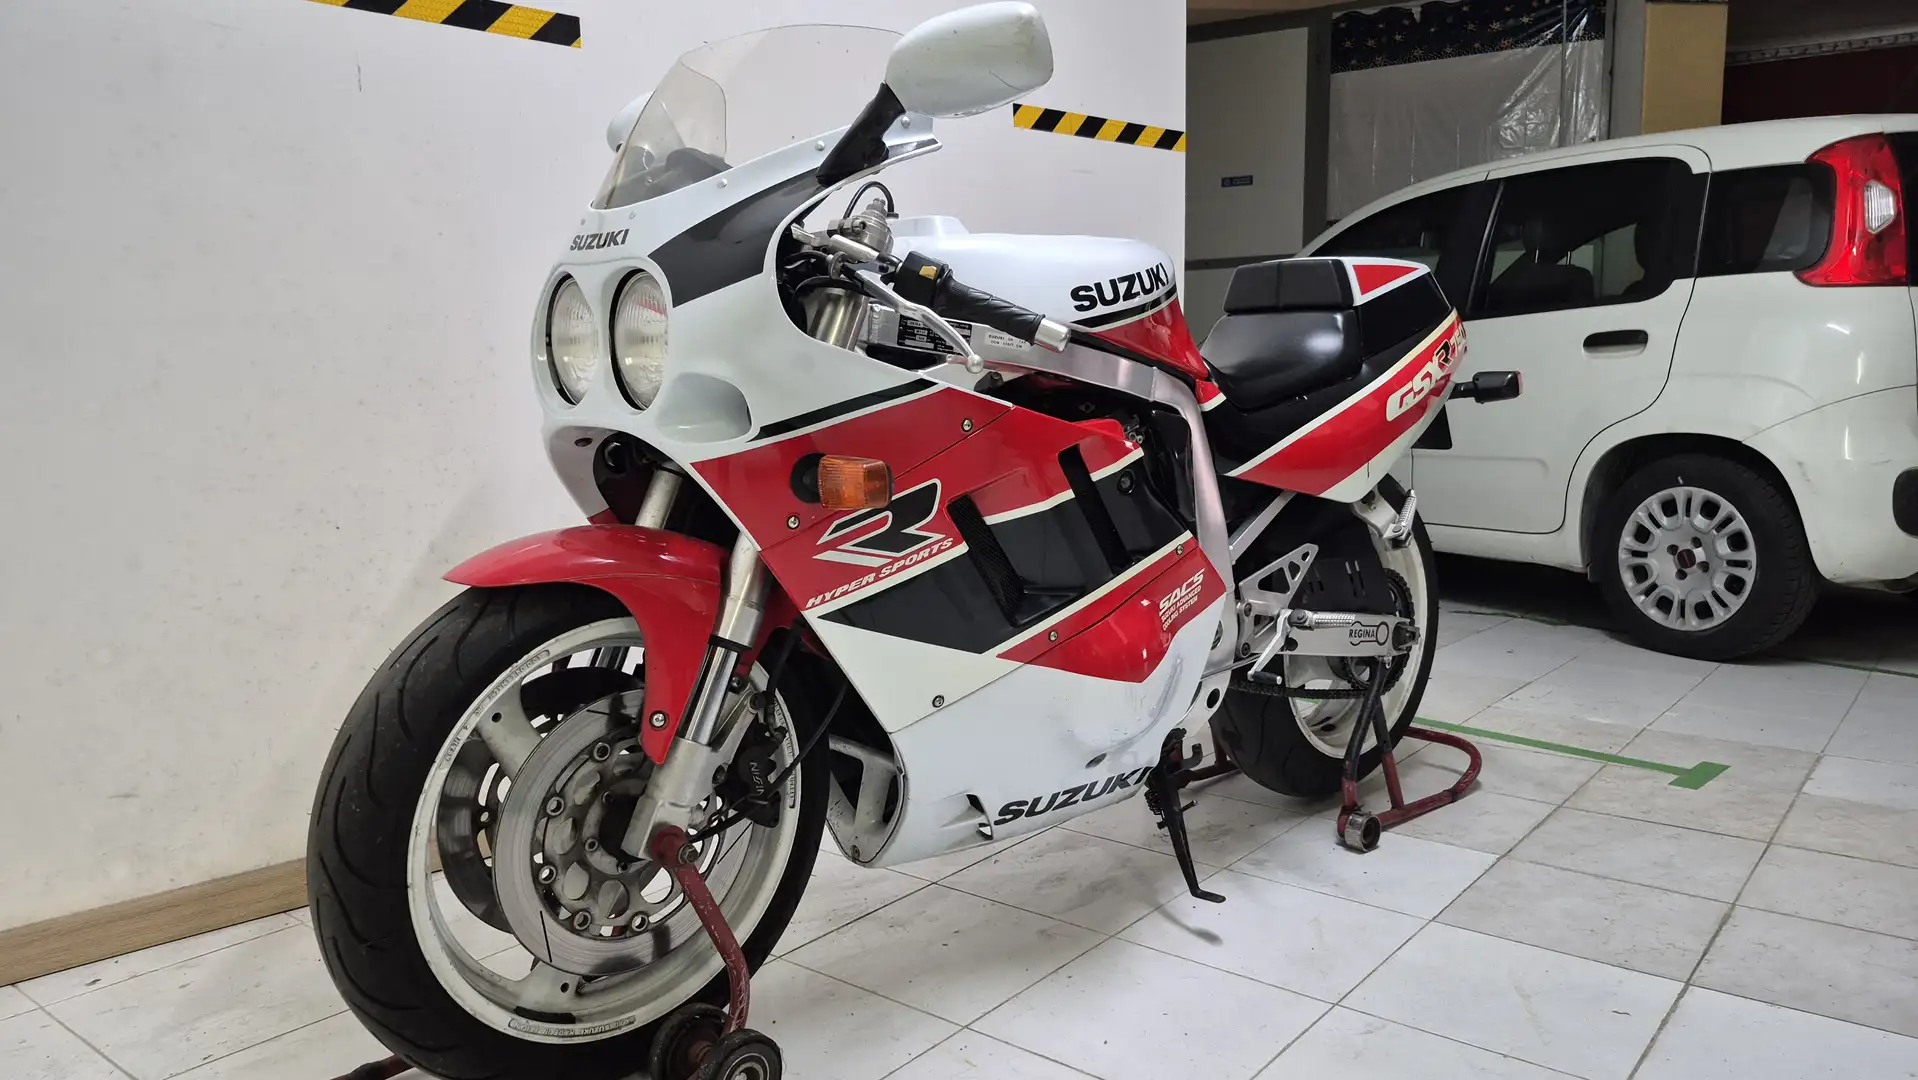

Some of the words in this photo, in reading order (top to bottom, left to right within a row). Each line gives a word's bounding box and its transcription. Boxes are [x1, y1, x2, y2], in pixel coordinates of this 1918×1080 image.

[570, 229, 629, 251] SUZUKI
[1070, 262, 1169, 312] SUZUKI
[812, 478, 946, 567] R
[805, 572, 876, 609] HYPER
[878, 537, 954, 577] SPORTS
[1159, 567, 1205, 616] SACS
[1161, 603, 1176, 623] SUZUKI
[1176, 585, 1202, 608] ADVANCED
[1163, 610, 1178, 631] COOLING
[1179, 595, 1198, 614] SYSTEM
[1348, 628, 1375, 639] REGINA
[994, 766, 1155, 826] SUZUKI
